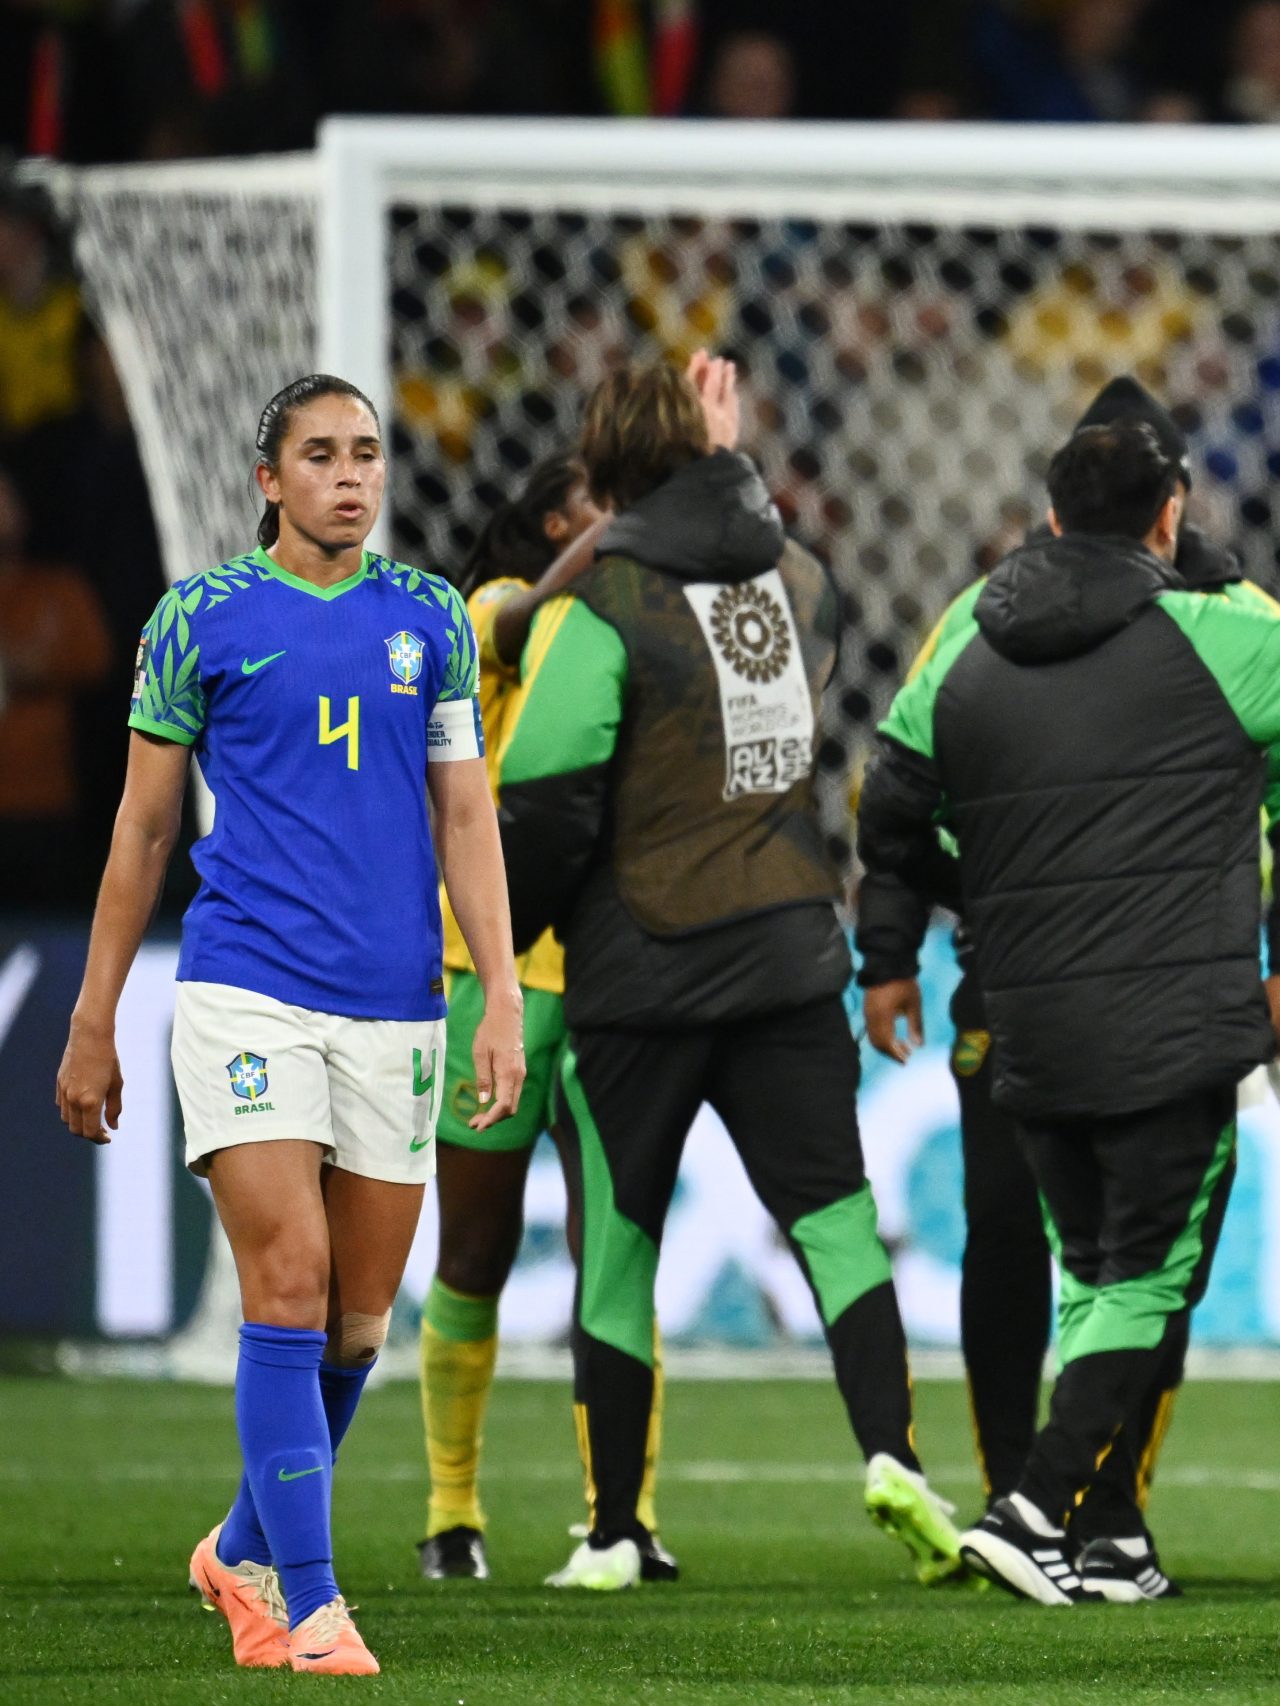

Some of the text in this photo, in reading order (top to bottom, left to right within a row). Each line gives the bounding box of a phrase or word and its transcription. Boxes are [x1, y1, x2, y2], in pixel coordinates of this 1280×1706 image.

[390, 683, 419, 696] BRASIL
[727, 694, 757, 711] FIFA
[318, 695, 360, 771] 4
[240, 1071, 256, 1080] CBF
[412, 1047, 438, 1122] 4
[234, 1102, 275, 1116] BRASIL
